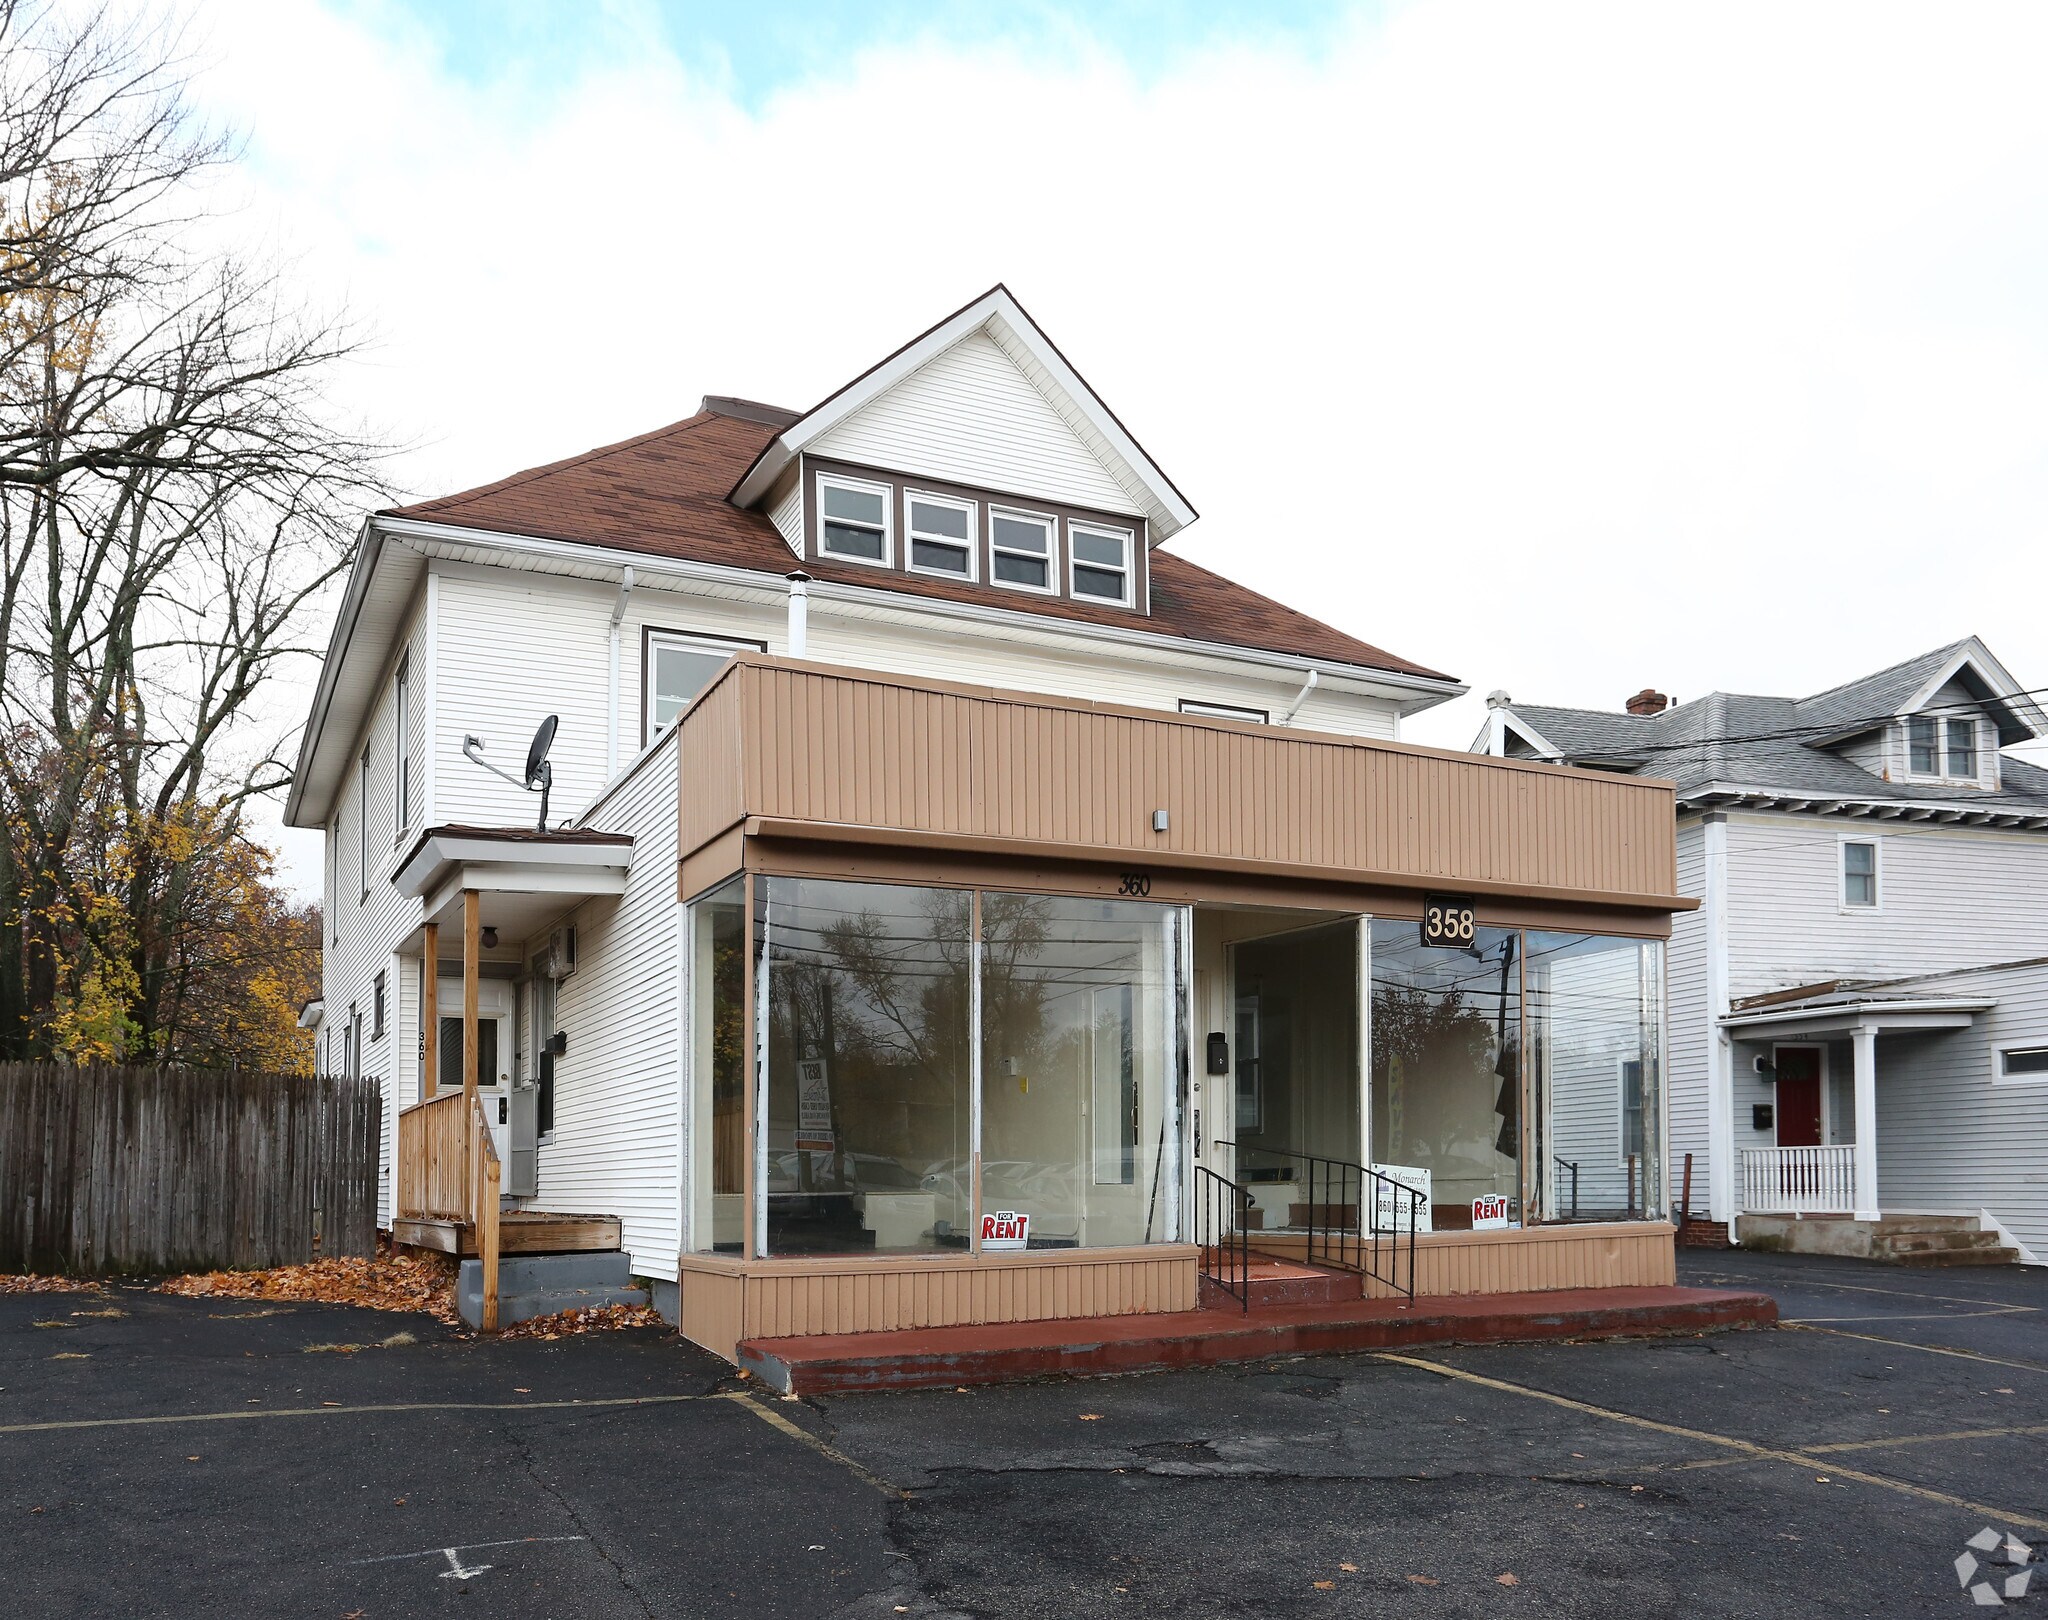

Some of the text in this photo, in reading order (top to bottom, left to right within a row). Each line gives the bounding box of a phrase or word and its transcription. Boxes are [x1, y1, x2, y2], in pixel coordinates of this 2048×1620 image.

[1118, 872, 1151, 897] 360
[1427, 907, 1474, 939] 358
[1392, 1172, 1426, 1185] Monarch
[1395, 1201, 1427, 1216] 655-555
[1474, 1199, 1505, 1220] RENT
[981, 1217, 1027, 1239] RENT
